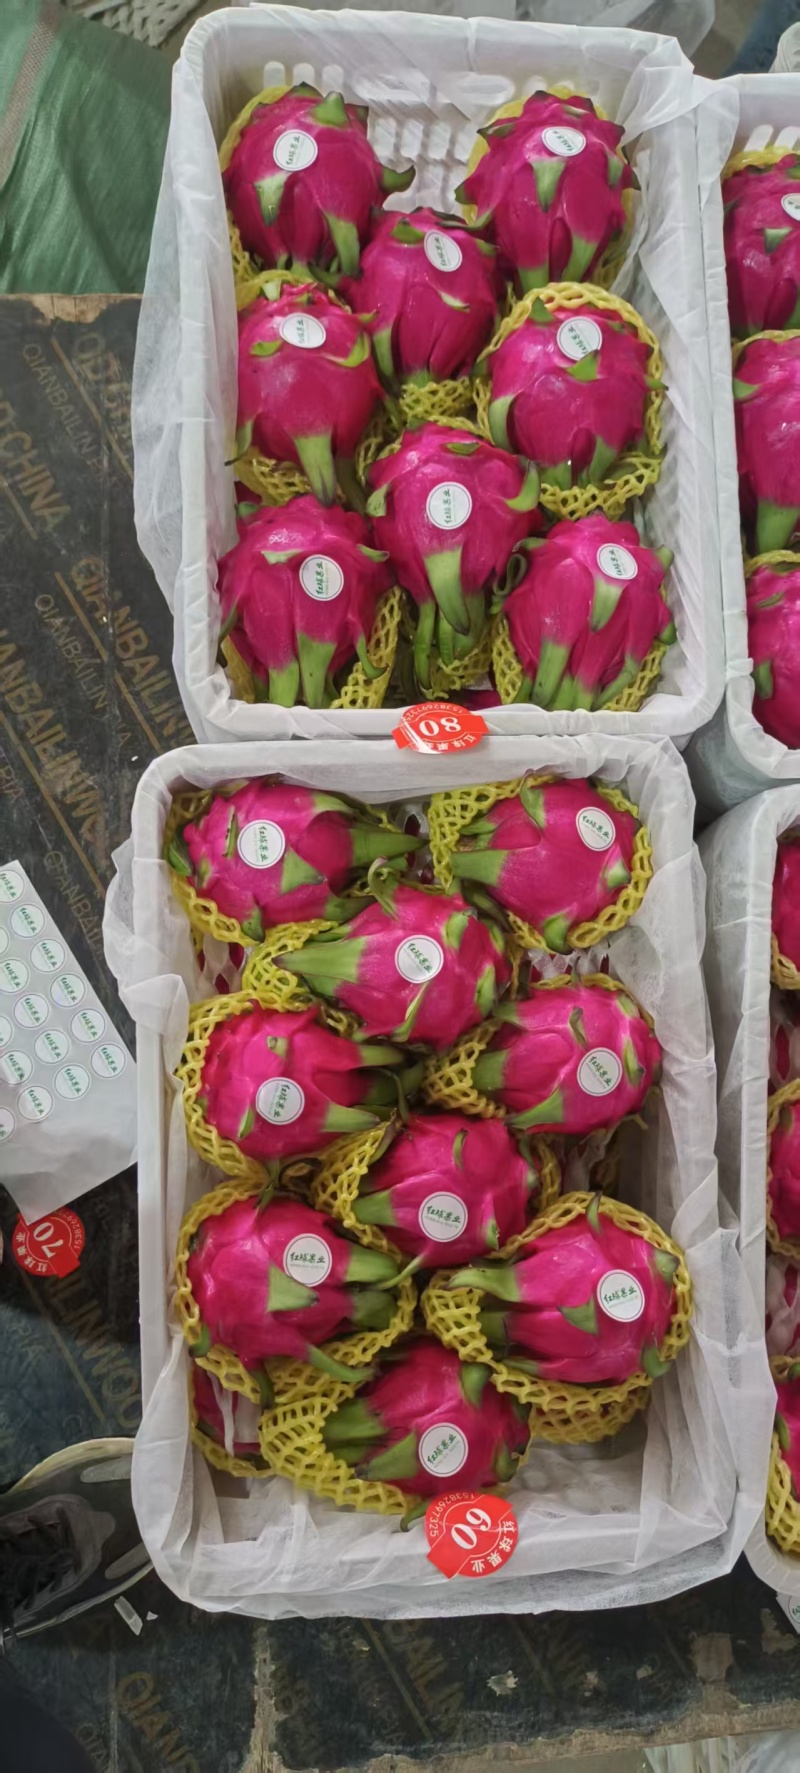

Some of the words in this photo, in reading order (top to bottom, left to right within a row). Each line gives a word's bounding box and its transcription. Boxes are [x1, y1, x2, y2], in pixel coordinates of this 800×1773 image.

[419, 717, 461, 737] 80
[33, 1222, 63, 1258] 70
[429, 1492, 474, 1537] 15382697325
[451, 1508, 491, 1550] 60
[471, 1521, 516, 1573] 红球果业
